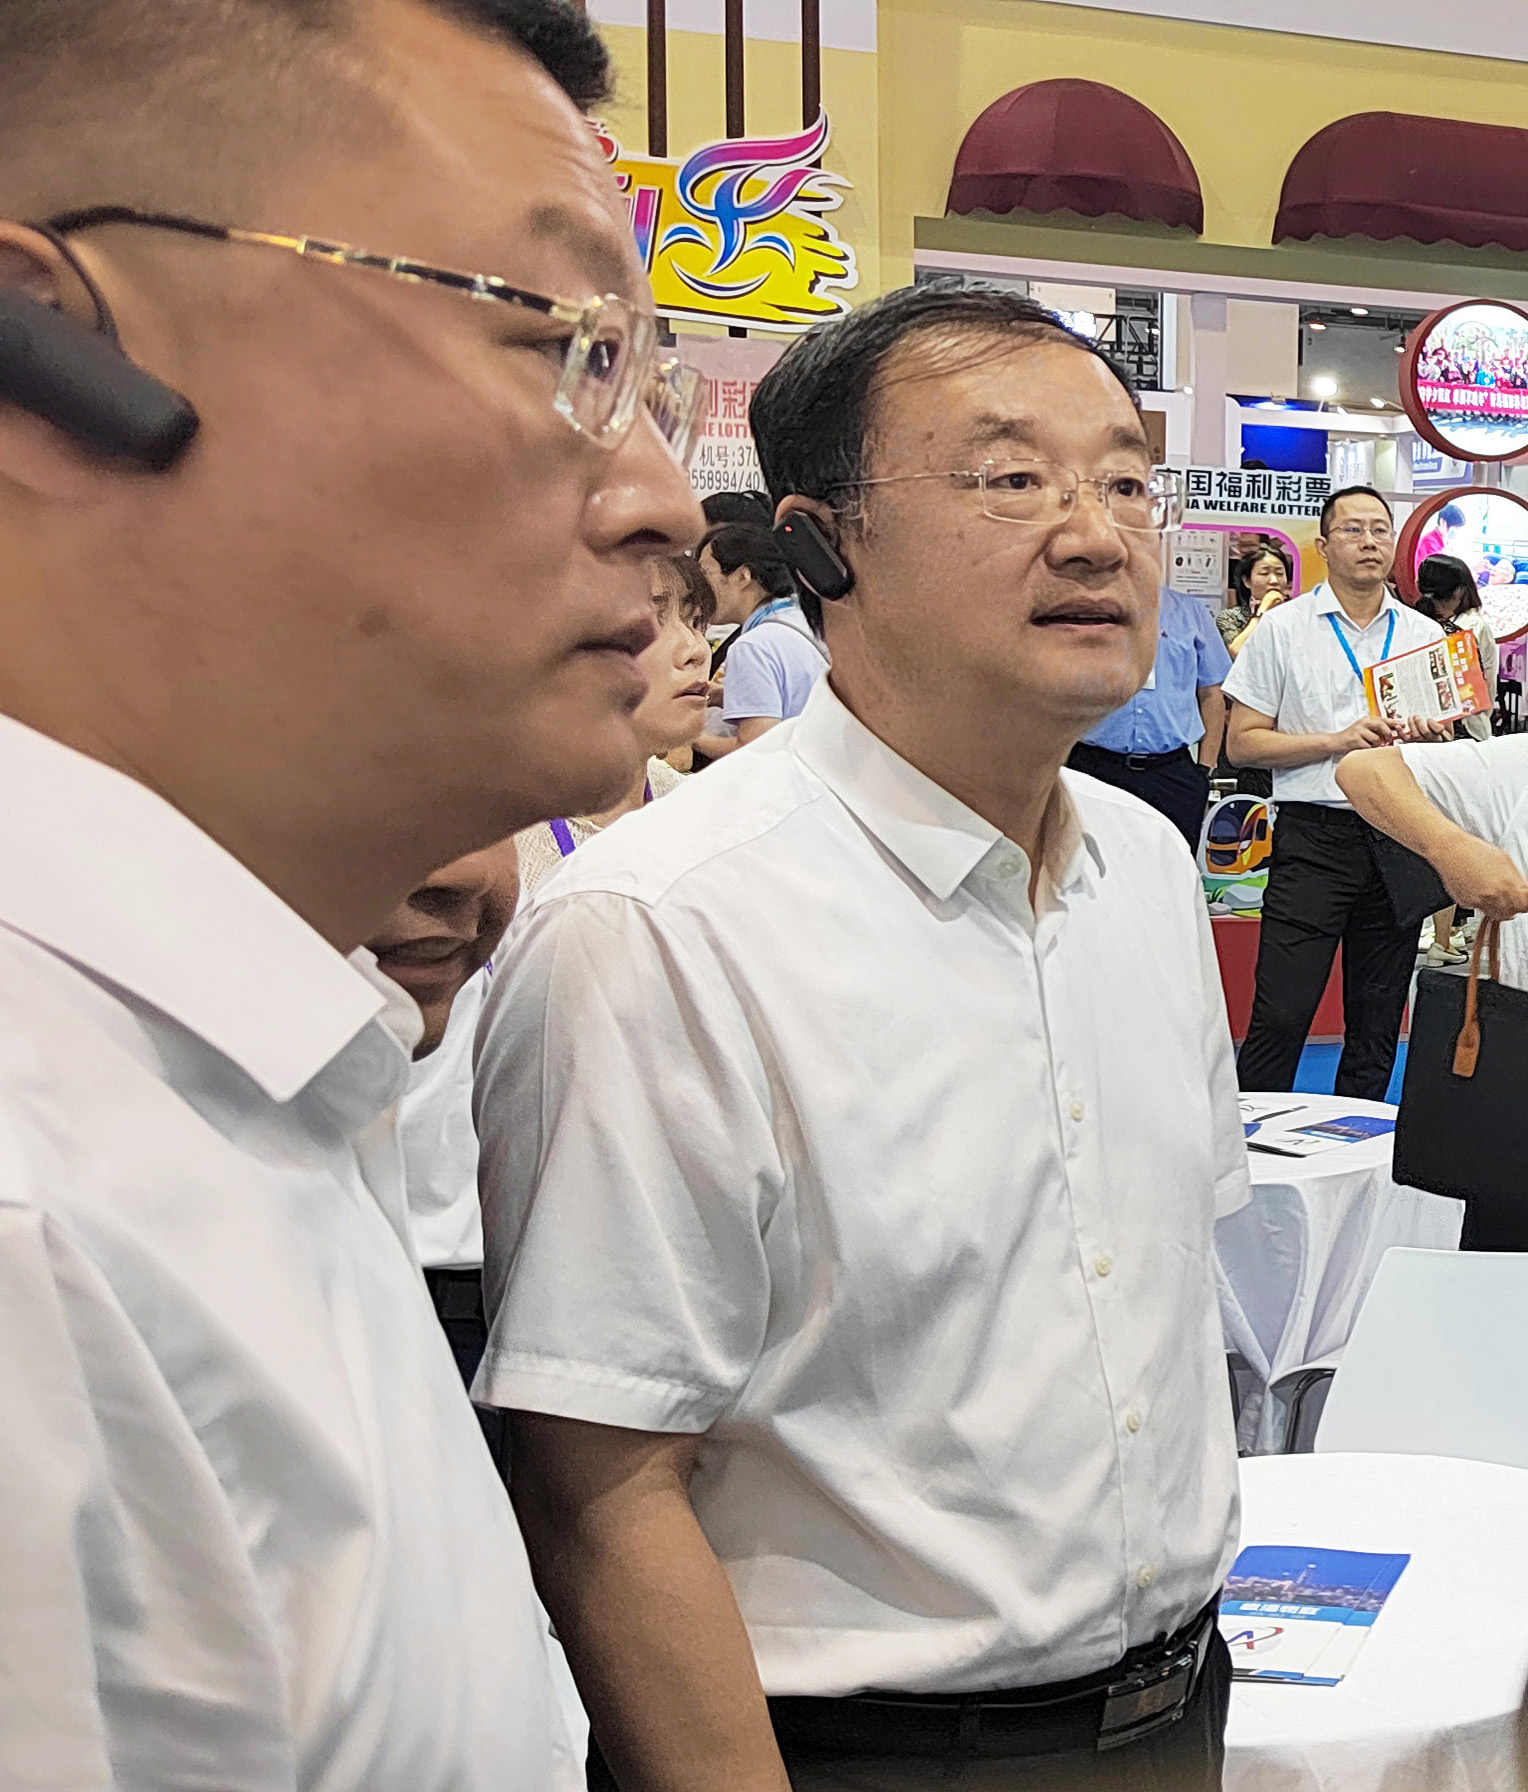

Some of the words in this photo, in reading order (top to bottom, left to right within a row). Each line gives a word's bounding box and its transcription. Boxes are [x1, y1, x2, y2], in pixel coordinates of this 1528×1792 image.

[718, 422, 753, 439] LOTT
[689, 469, 768, 492] 558994/40
[1156, 468, 1331, 503] 国福利彩票
[1204, 499, 1268, 514] WELFARE
